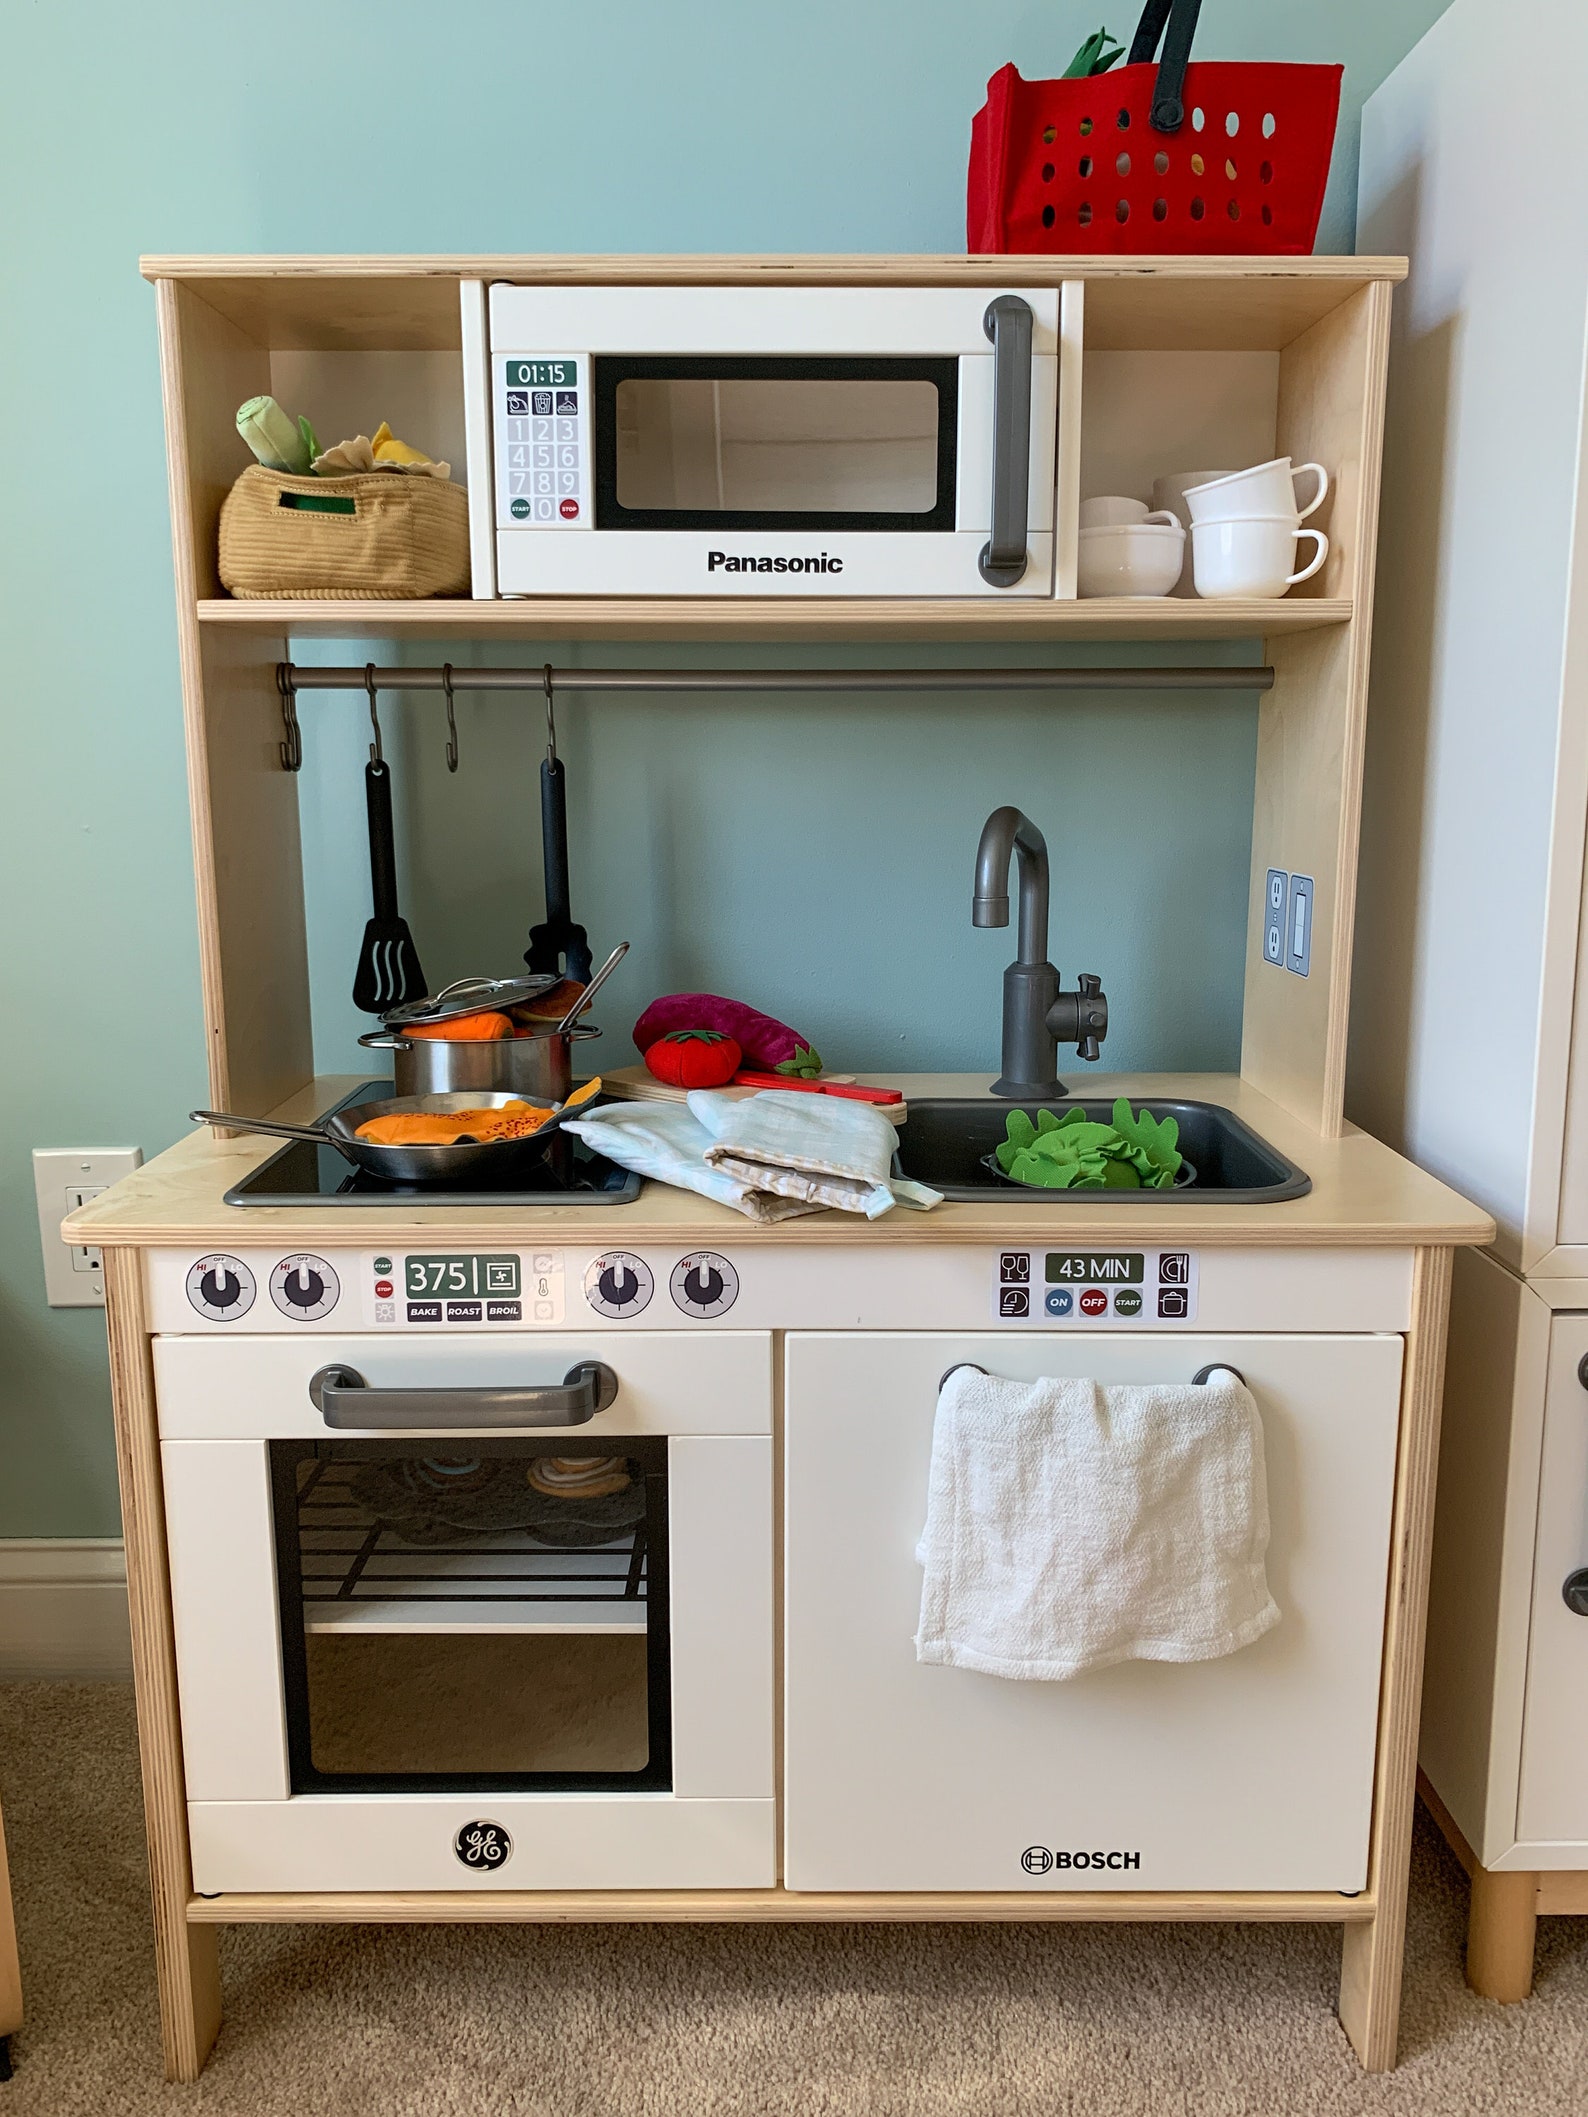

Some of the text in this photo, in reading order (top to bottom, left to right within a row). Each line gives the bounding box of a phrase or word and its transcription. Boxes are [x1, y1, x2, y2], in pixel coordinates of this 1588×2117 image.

[518, 364, 565, 383] 01:15
[515, 420, 574, 440] 1 2 3
[513, 446, 574, 467] 4 5 6
[514, 472, 575, 494] 7 8 9
[538, 499, 552, 519] 0
[707, 551, 843, 573] Panasonic
[280, 1263, 328, 1271] HI LO
[409, 1262, 467, 1292] 375
[1059, 1258, 1130, 1278] 43 MIN
[410, 1307, 519, 1316] BAKE ROAST BROIL
[1050, 1298, 1068, 1307] ON
[1081, 1298, 1106, 1307] OFF
[1056, 1851, 1140, 1869] BOSCH
